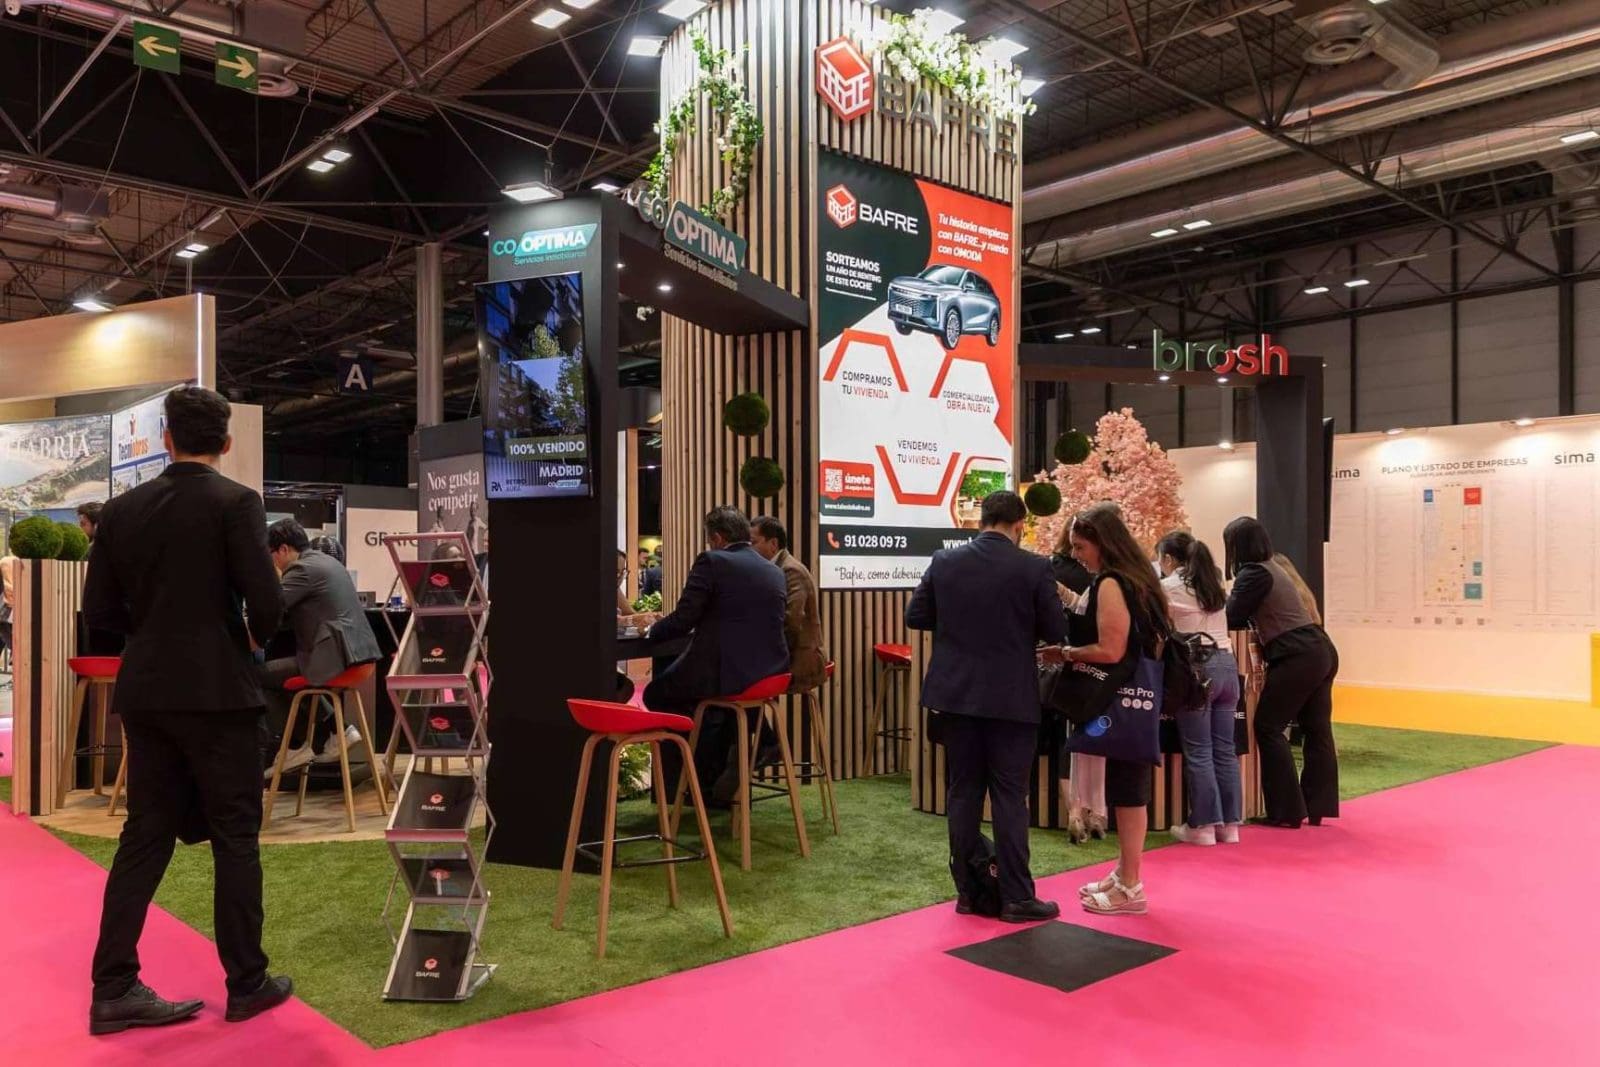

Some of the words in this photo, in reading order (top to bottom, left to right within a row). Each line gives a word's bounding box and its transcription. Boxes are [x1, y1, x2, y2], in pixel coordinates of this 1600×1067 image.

[877, 72, 1017, 165] BAFRE
[859, 203, 919, 235] BAFRE
[938, 213, 949, 226] Tu
[949, 215, 978, 233] historia
[521, 230, 588, 252] OPTIMA
[672, 210, 738, 270] OPTIMA
[937, 231, 953, 240] con
[663, 243, 698, 271] Servicios
[826, 251, 880, 272] SORTEAMOS
[937, 246, 953, 255] con
[953, 247, 982, 262] OMODA
[825, 264, 836, 272] UN
[836, 266, 849, 275] AÑO
[849, 269, 857, 278] DE
[857, 272, 882, 283] RENTING
[825, 274, 834, 283] DE
[835, 276, 849, 287] ESTE
[849, 279, 873, 291] COCHE
[1153, 329, 1289, 376] brosh
[344, 363, 368, 391] A
[842, 370, 893, 387] COMPRAMOS
[842, 384, 852, 395] TU
[853, 387, 889, 400] VIVIENDA
[943, 390, 995, 404] COMERCIALIZAMOS
[946, 400, 966, 412] OBRA
[967, 402, 991, 414] NUEVA
[509, 443, 536, 455] 100%
[537, 441, 585, 453] VENDIDO
[897, 439, 938, 452] VENDEMOS
[897, 453, 907, 464] TU
[908, 455, 941, 466] VIVIENDA
[1382, 466, 1412, 474] PLANO
[1421, 462, 1460, 472] LISTADO
[1462, 461, 1475, 469] DE
[1477, 457, 1528, 468] EMPRESAS
[1554, 451, 1595, 465] sima
[539, 465, 584, 477] MADRID
[845, 472, 871, 485] únete
[427, 472, 447, 491] Nos
[449, 470, 480, 494] gusta
[428, 489, 479, 515] competir
[844, 535, 857, 547] 91
[857, 535, 879, 547] 028
[880, 536, 893, 548] 09
[893, 537, 907, 549] 73
[867, 568, 890, 580] como
[1079, 662, 1109, 681] BAFRE
[1137, 687, 1154, 698] Pro
[421, 804, 446, 812] BAFRE
